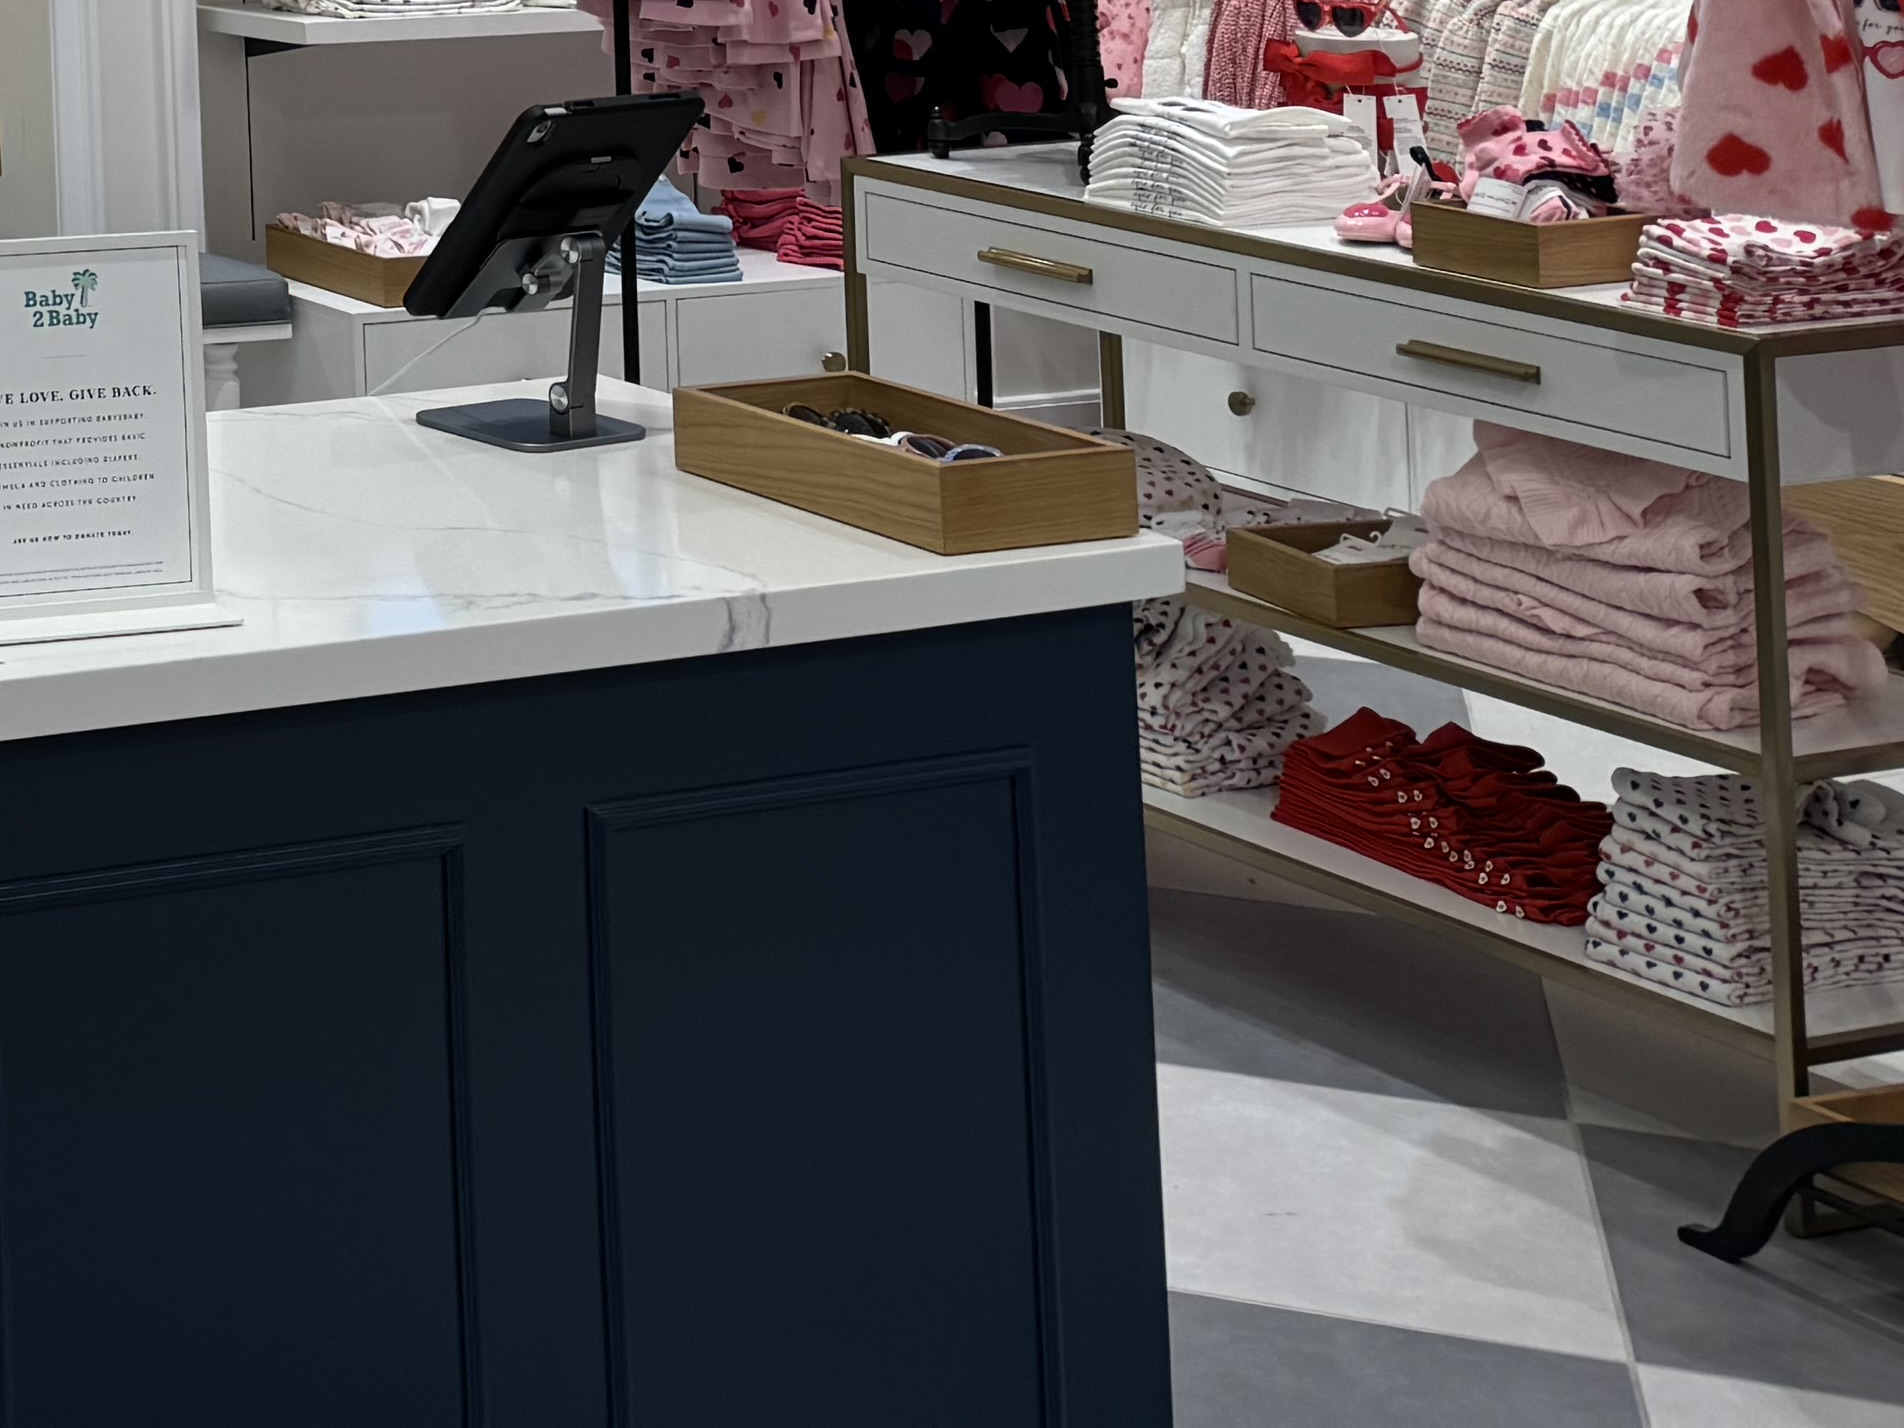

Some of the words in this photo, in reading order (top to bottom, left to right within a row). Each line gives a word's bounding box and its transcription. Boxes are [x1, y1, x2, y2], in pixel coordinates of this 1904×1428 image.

[24, 289, 76, 311] Baby
[20, 390, 64, 404] LOVE.
[69, 387, 106, 401] GIVE
[112, 384, 157, 398] BACK.
[29, 480, 46, 488] AND
[49, 478, 94, 488] CLOTHING
[98, 476, 108, 484] TO
[111, 472, 155, 483] CHILDREN
[15, 502, 38, 510] NEED
[41, 499, 74, 508] ACROSS
